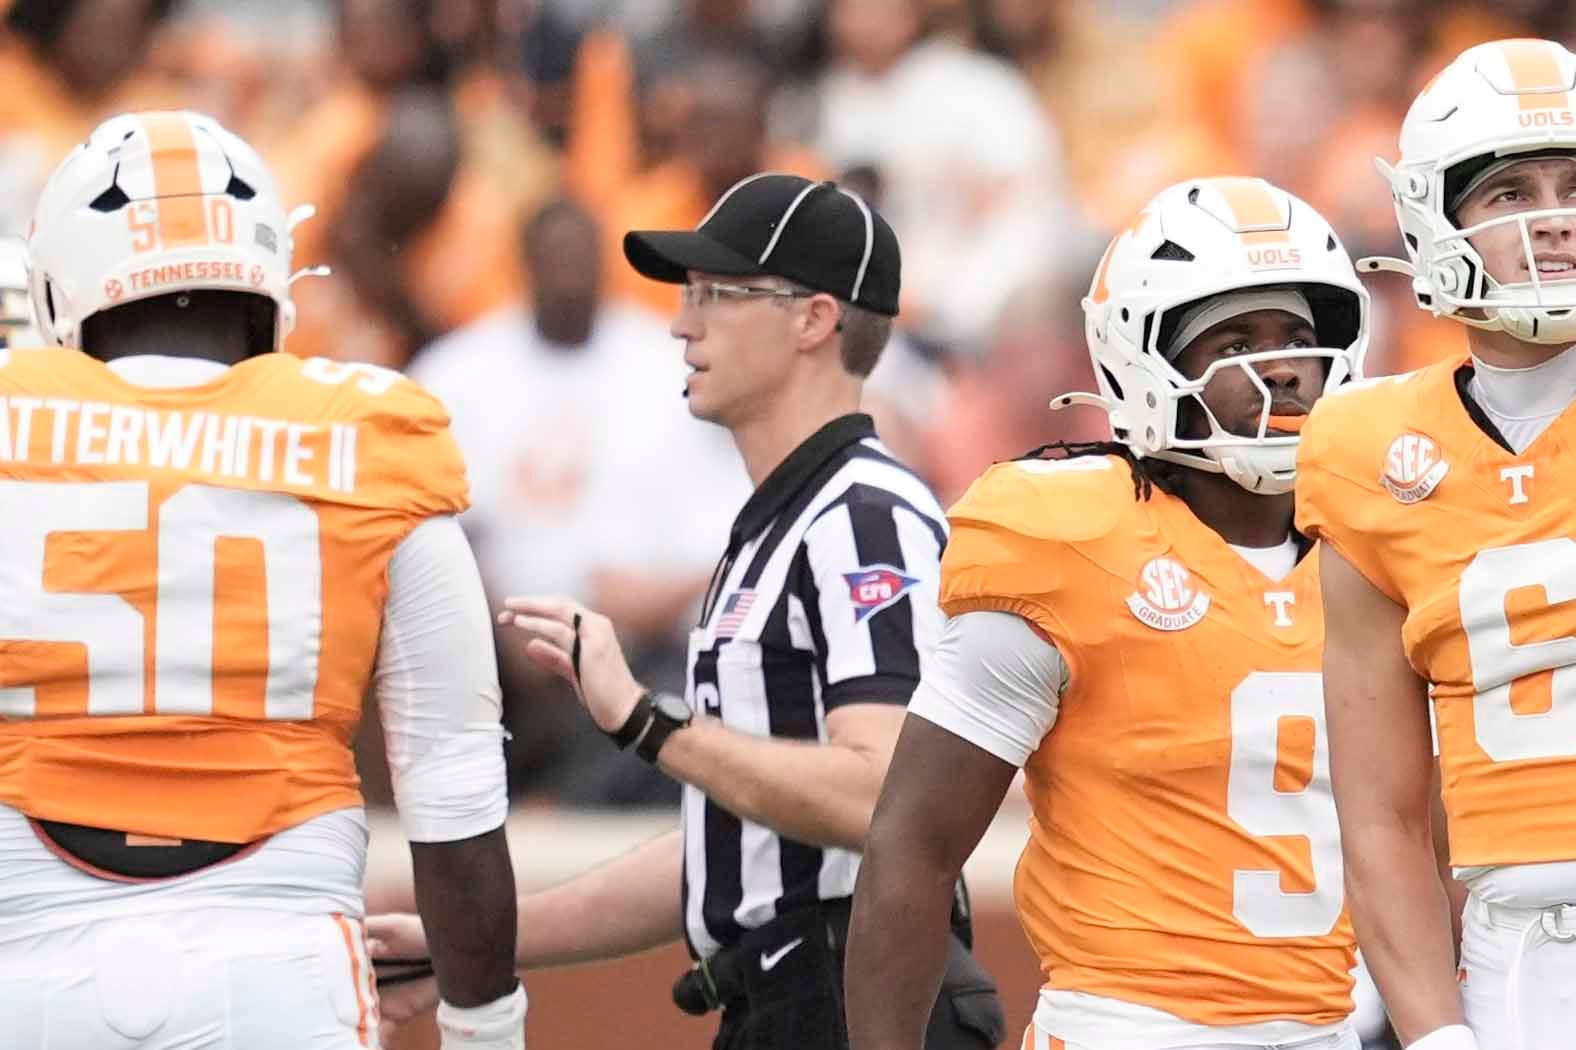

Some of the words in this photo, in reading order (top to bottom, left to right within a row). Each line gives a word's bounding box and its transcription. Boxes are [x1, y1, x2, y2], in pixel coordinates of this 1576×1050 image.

[1517, 110, 1575, 128] VOLS
[130, 261, 245, 290] TENNESSEE
[1247, 248, 1302, 266] VOLS
[328, 423, 357, 494] II
[1386, 435, 1435, 482] SEC
[1500, 465, 1536, 505] T
[0, 480, 322, 721] 50
[1143, 558, 1194, 609] SEC
[1137, 604, 1204, 629] GRADUATE
[1263, 591, 1296, 627] T
[1227, 671, 1346, 939] 9
